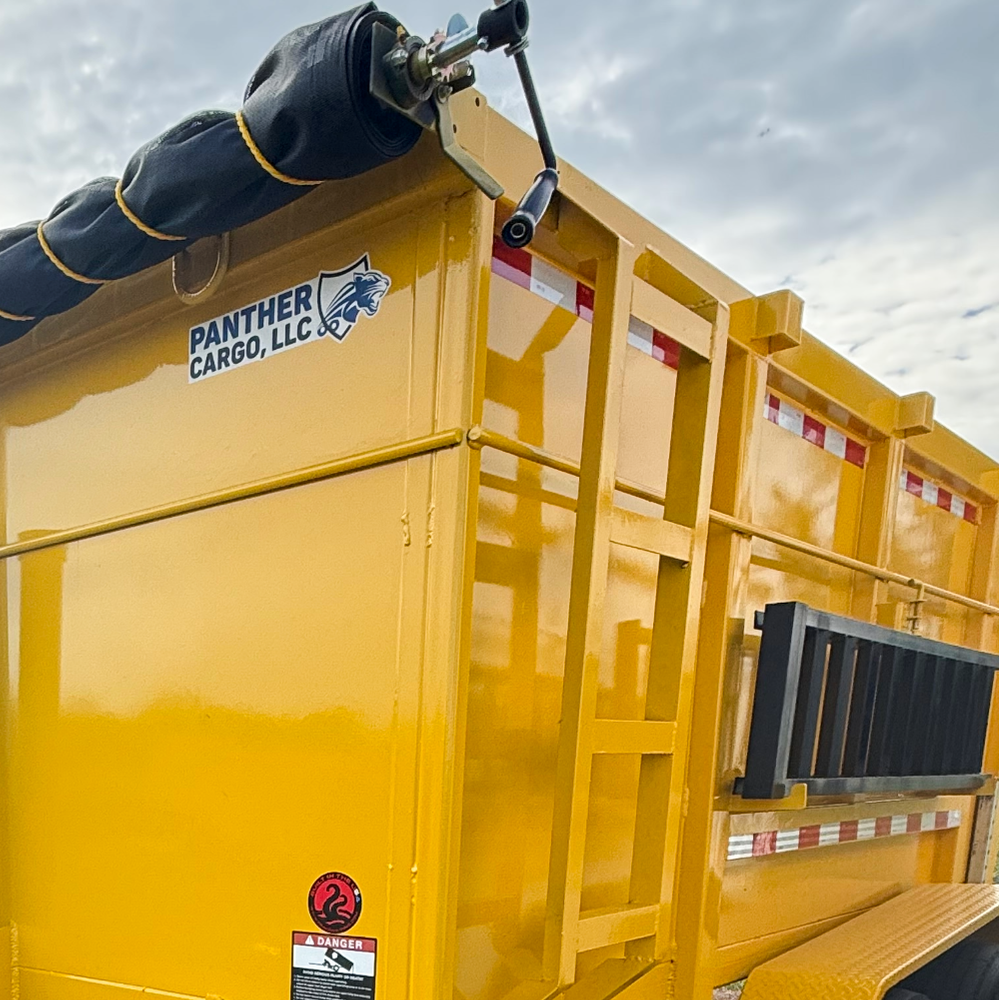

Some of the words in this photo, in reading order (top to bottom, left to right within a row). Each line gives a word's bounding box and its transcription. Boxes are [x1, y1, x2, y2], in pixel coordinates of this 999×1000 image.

[189, 283, 313, 355] PANTHER
[189, 334, 267, 380] CARGO,
[271, 316, 312, 351] LLC
[317, 936, 363, 950] DANGER
